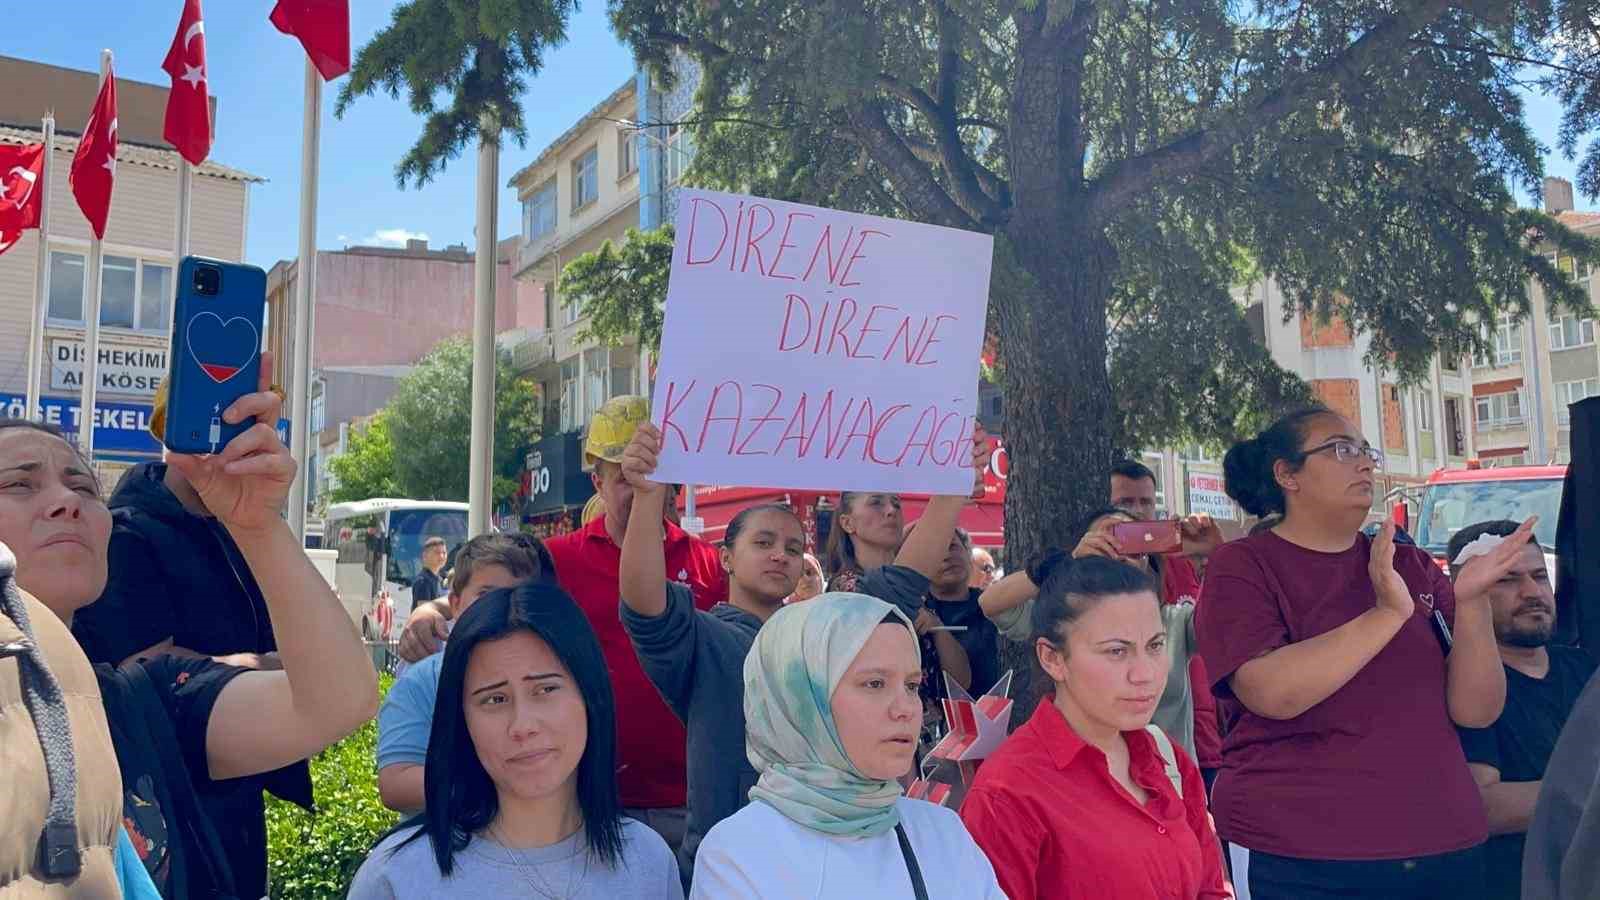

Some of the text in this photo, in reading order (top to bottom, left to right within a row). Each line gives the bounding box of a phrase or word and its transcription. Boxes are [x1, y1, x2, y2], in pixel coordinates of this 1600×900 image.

[686, 198, 891, 287] DİRENE
[779, 290, 959, 365] DİRENE
[98, 349, 166, 369] HEKİMİ
[102, 371, 161, 390] KÖSE
[69, 405, 149, 431] TEKEL
